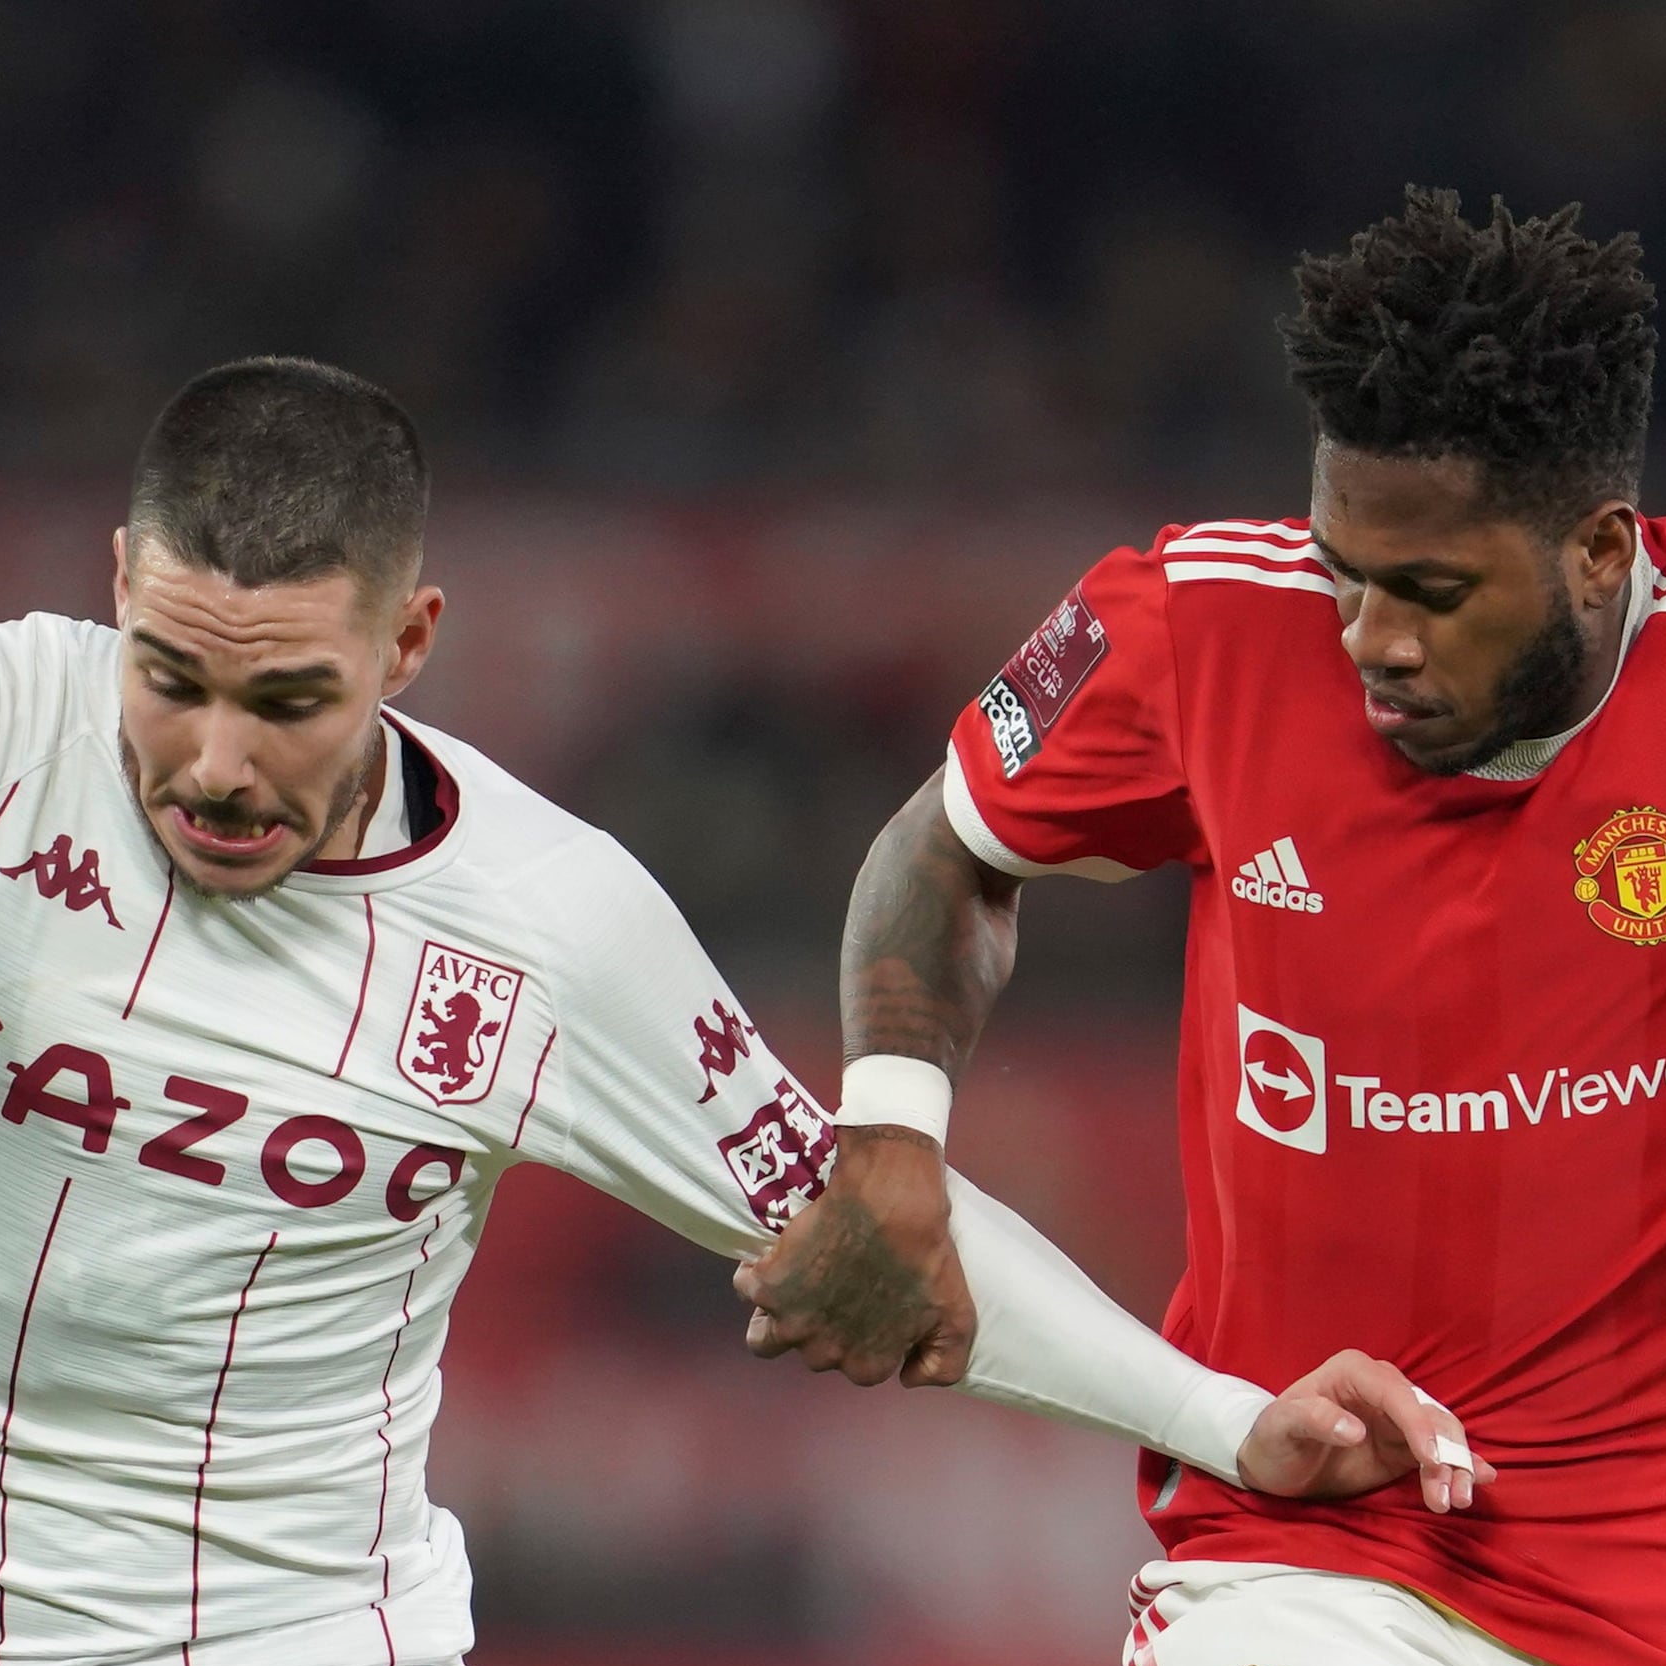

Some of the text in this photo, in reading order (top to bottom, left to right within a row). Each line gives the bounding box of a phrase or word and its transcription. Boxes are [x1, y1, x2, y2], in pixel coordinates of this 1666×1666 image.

[1026, 656, 1058, 698] CUP
[980, 693, 1021, 779] racism
[992, 679, 1033, 753] room
[1231, 877, 1324, 914] adidas
[427, 954, 512, 1001] AVFC
